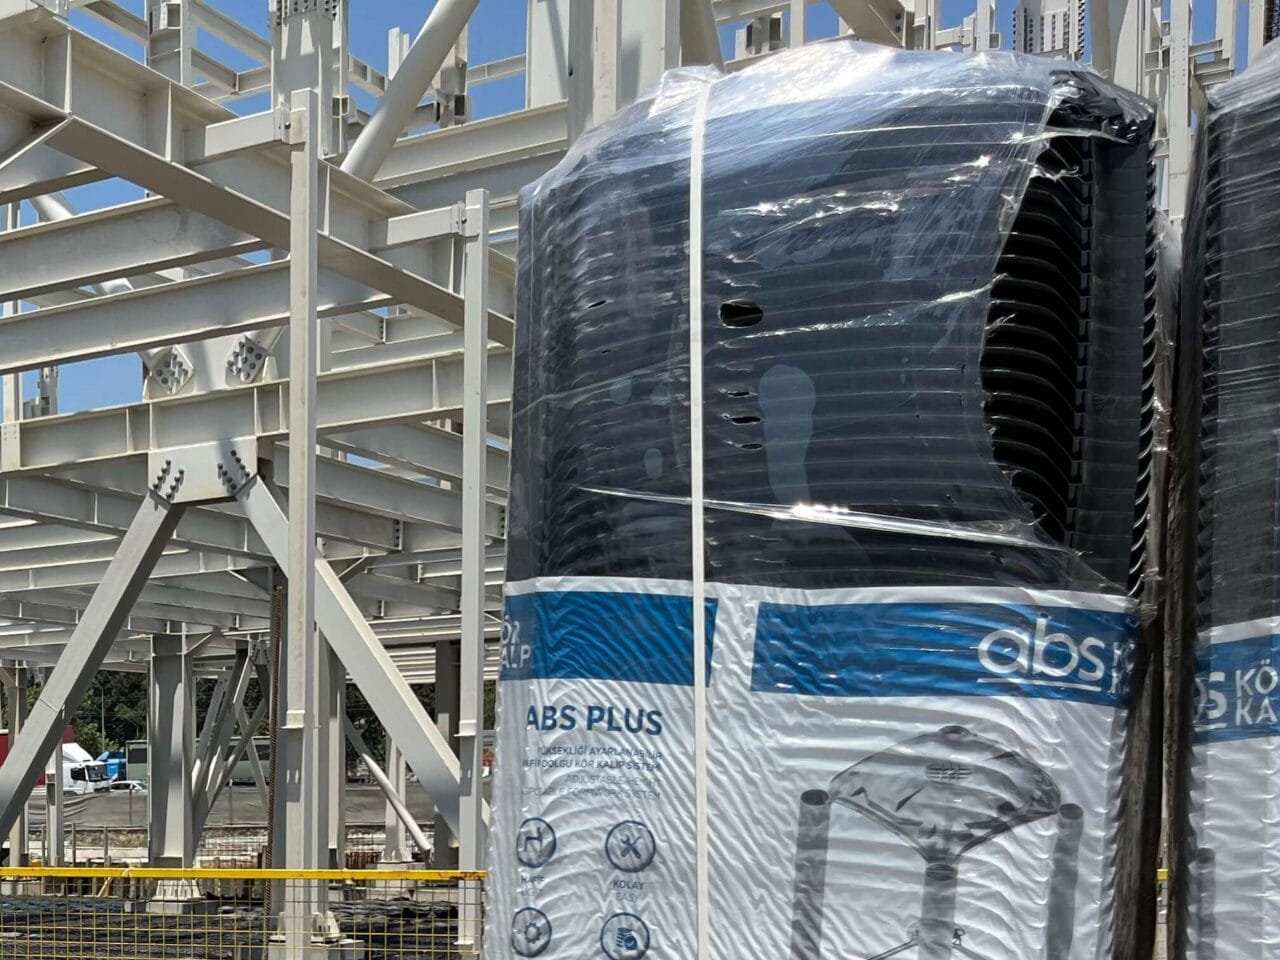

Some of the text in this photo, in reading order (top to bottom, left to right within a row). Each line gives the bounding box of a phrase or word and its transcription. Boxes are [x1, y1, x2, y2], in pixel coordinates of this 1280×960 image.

[978, 618, 1106, 682] abs
[1235, 658, 1279, 698] KÖ
[526, 704, 663, 736] ABS PLUS
[1235, 696, 1278, 726] KA
[612, 879, 645, 890] KOLAY
